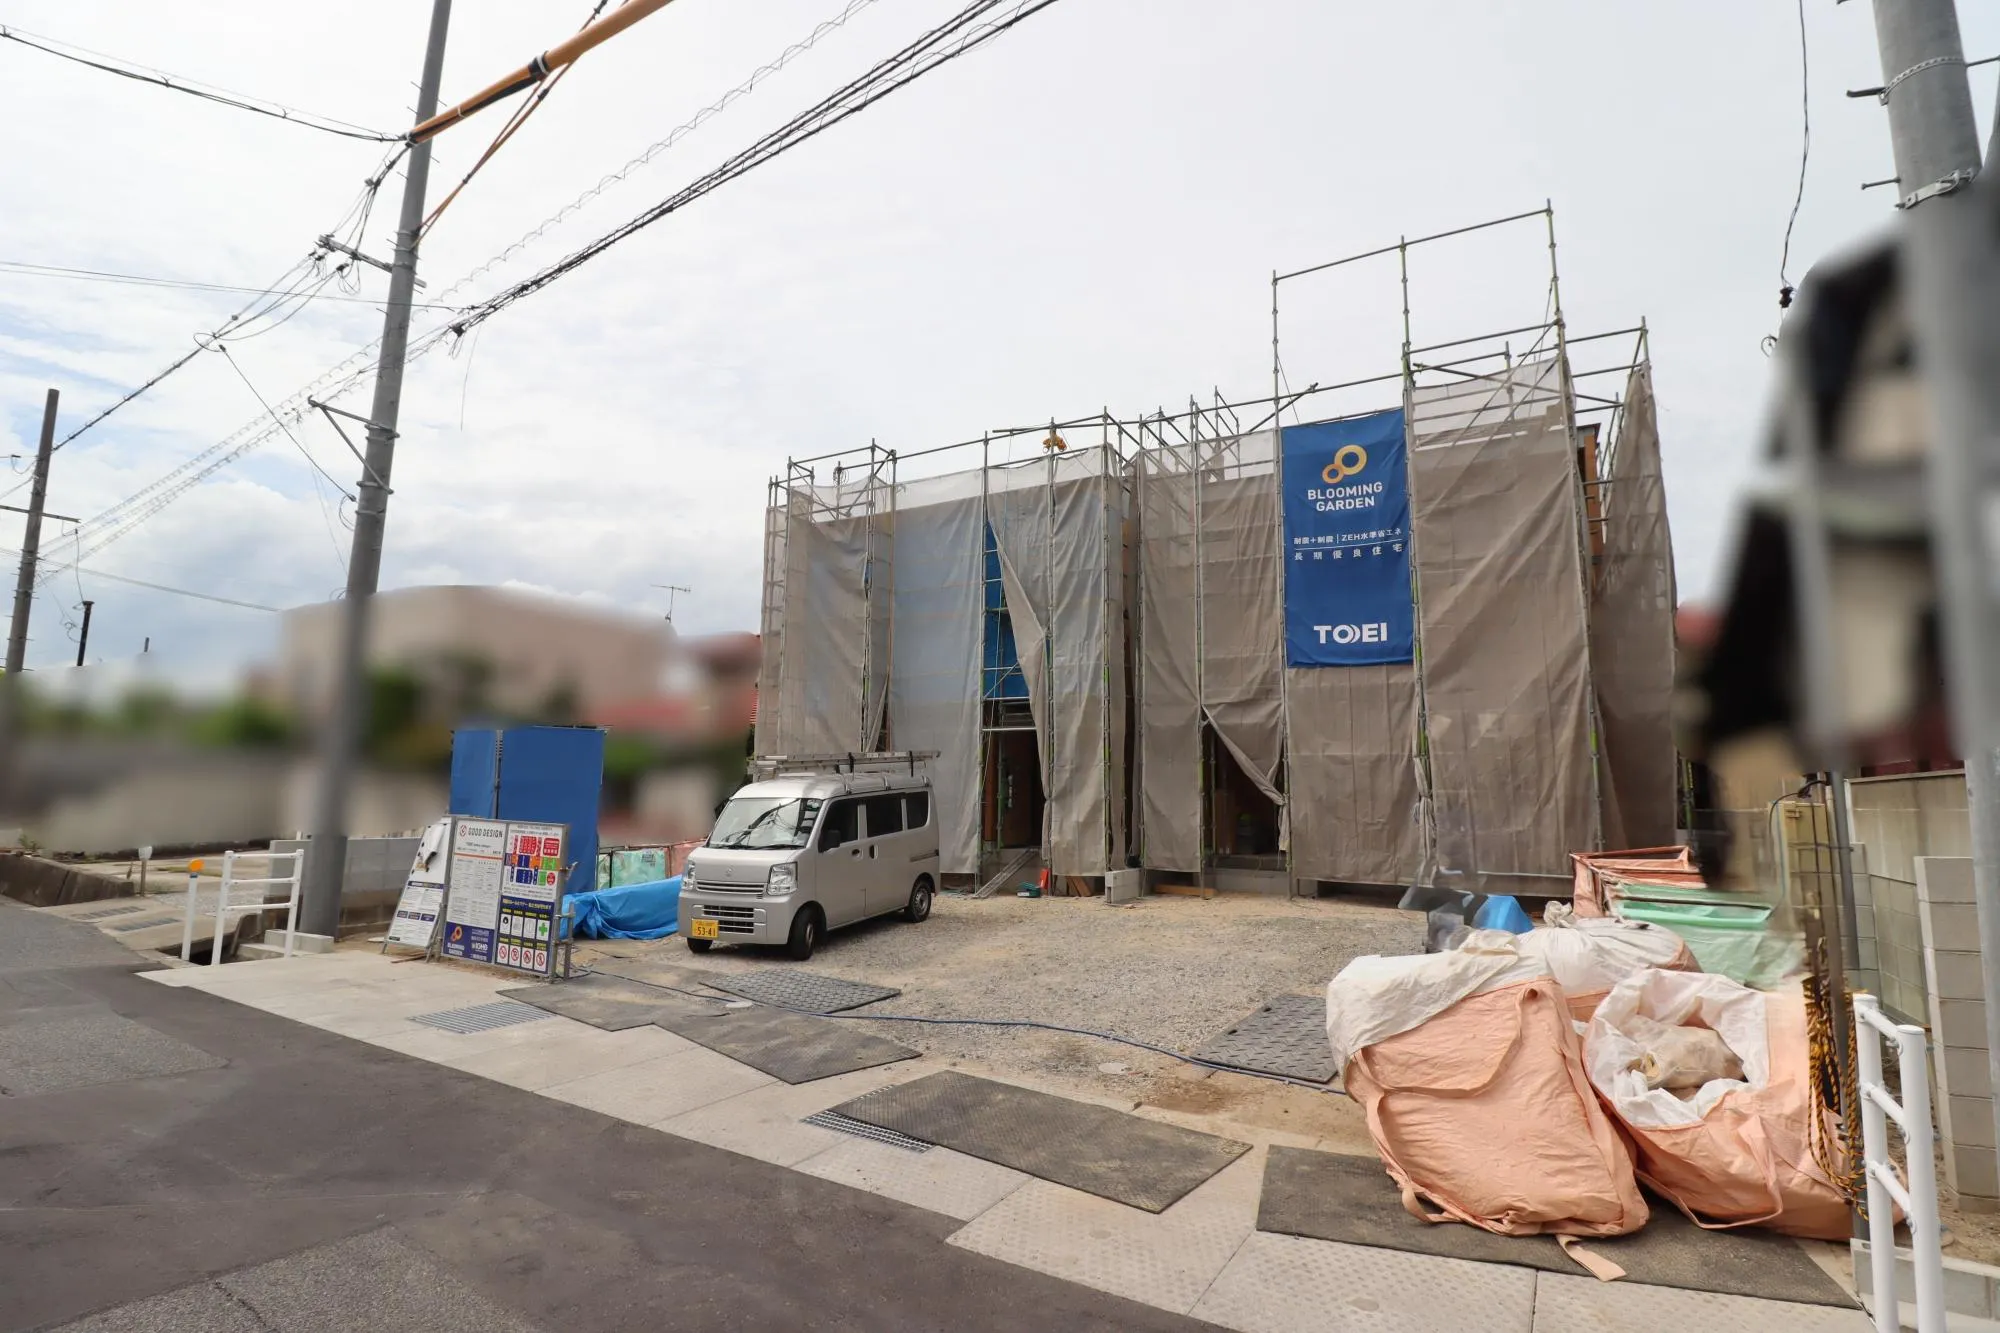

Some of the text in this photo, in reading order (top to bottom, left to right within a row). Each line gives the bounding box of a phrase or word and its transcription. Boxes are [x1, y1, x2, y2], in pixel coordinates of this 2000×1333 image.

[1308, 482, 1383, 500] BLOOMING
[1316, 496, 1375, 512] GARDEN
[468, 827, 482, 837] GOOD
[482, 828, 503, 838] DESIGN
